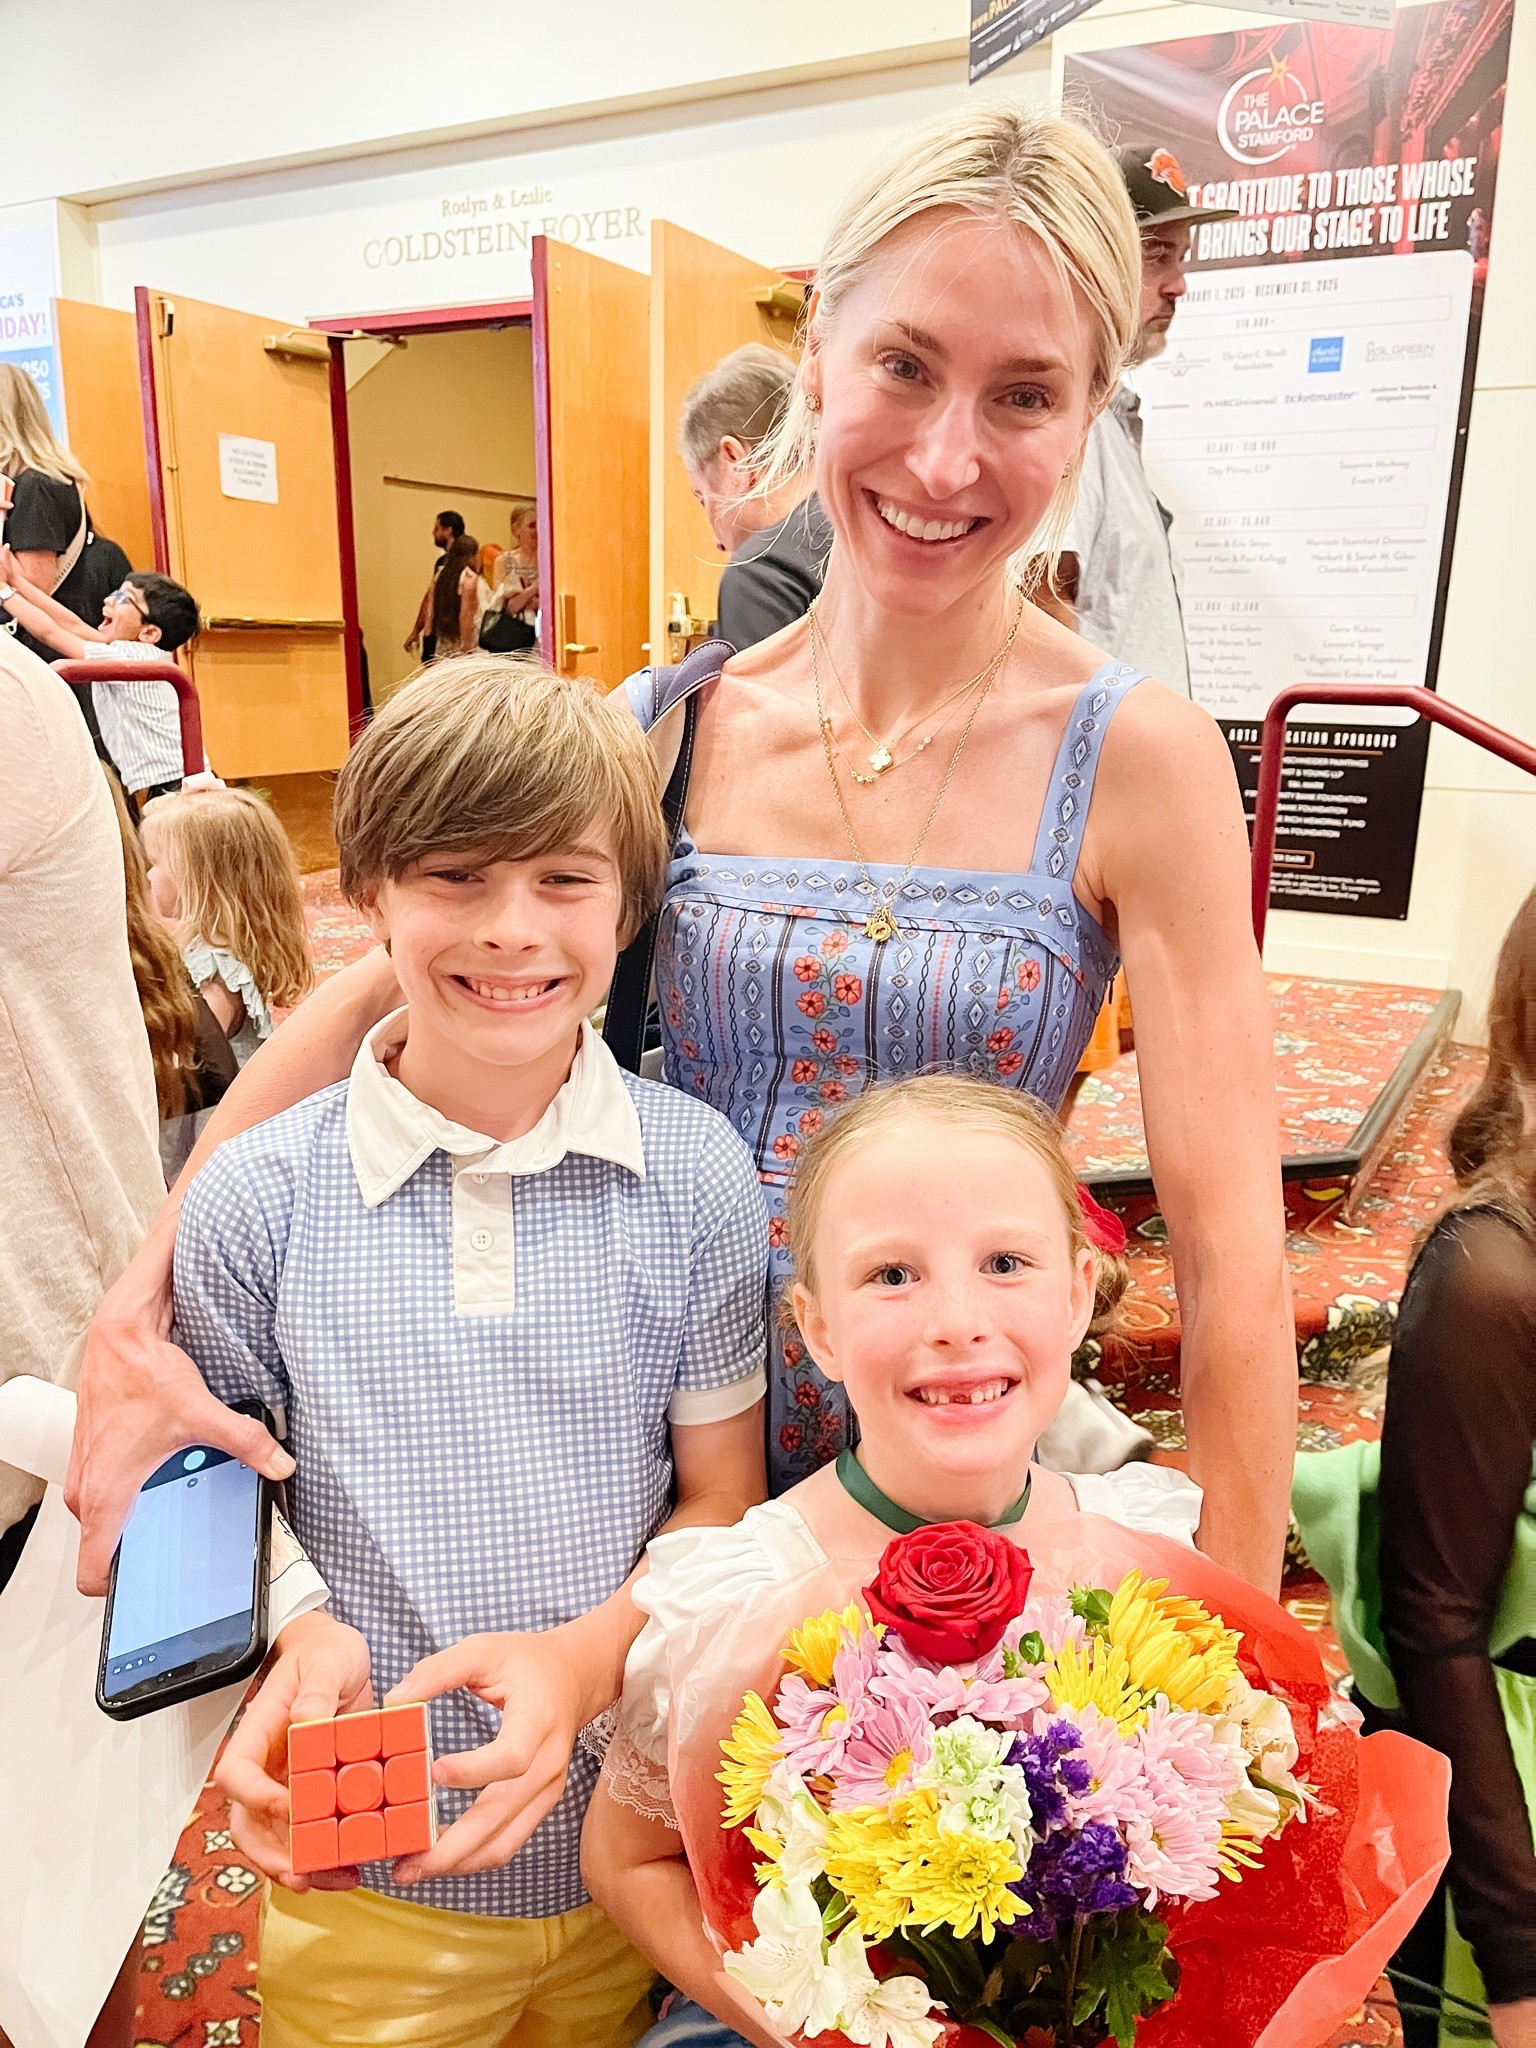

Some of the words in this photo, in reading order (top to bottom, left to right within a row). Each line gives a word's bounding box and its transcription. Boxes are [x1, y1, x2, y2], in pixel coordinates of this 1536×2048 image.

[1243, 92, 1270, 108] THE
[1235, 101, 1325, 132] PALACE
[1238, 127, 1314, 149] STAMFORD
[1202, 174, 1304, 216] GRATITUDE
[1308, 171, 1333, 210] TO
[1335, 164, 1399, 207] THOSE
[1401, 156, 1477, 200] WHOSE
[442, 196, 488, 217] Roslyn
[493, 193, 505, 210] &
[511, 186, 553, 208] Leslie
[363, 220, 530, 269] GOLDSTEIN
[541, 207, 645, 246] FOYER
[1197, 218, 1269, 261] BRINGS
[1270, 214, 1313, 254] OUR
[1313, 208, 1376, 250] STAGE
[1379, 204, 1405, 244] TO
[1406, 201, 1452, 242] LIFE
[0, 292, 25, 309] CA'S
[1255, 282, 1298, 297] DECEMBER
[1228, 728, 1258, 743] ARTS
[1334, 731, 1397, 748] SPONSORS
